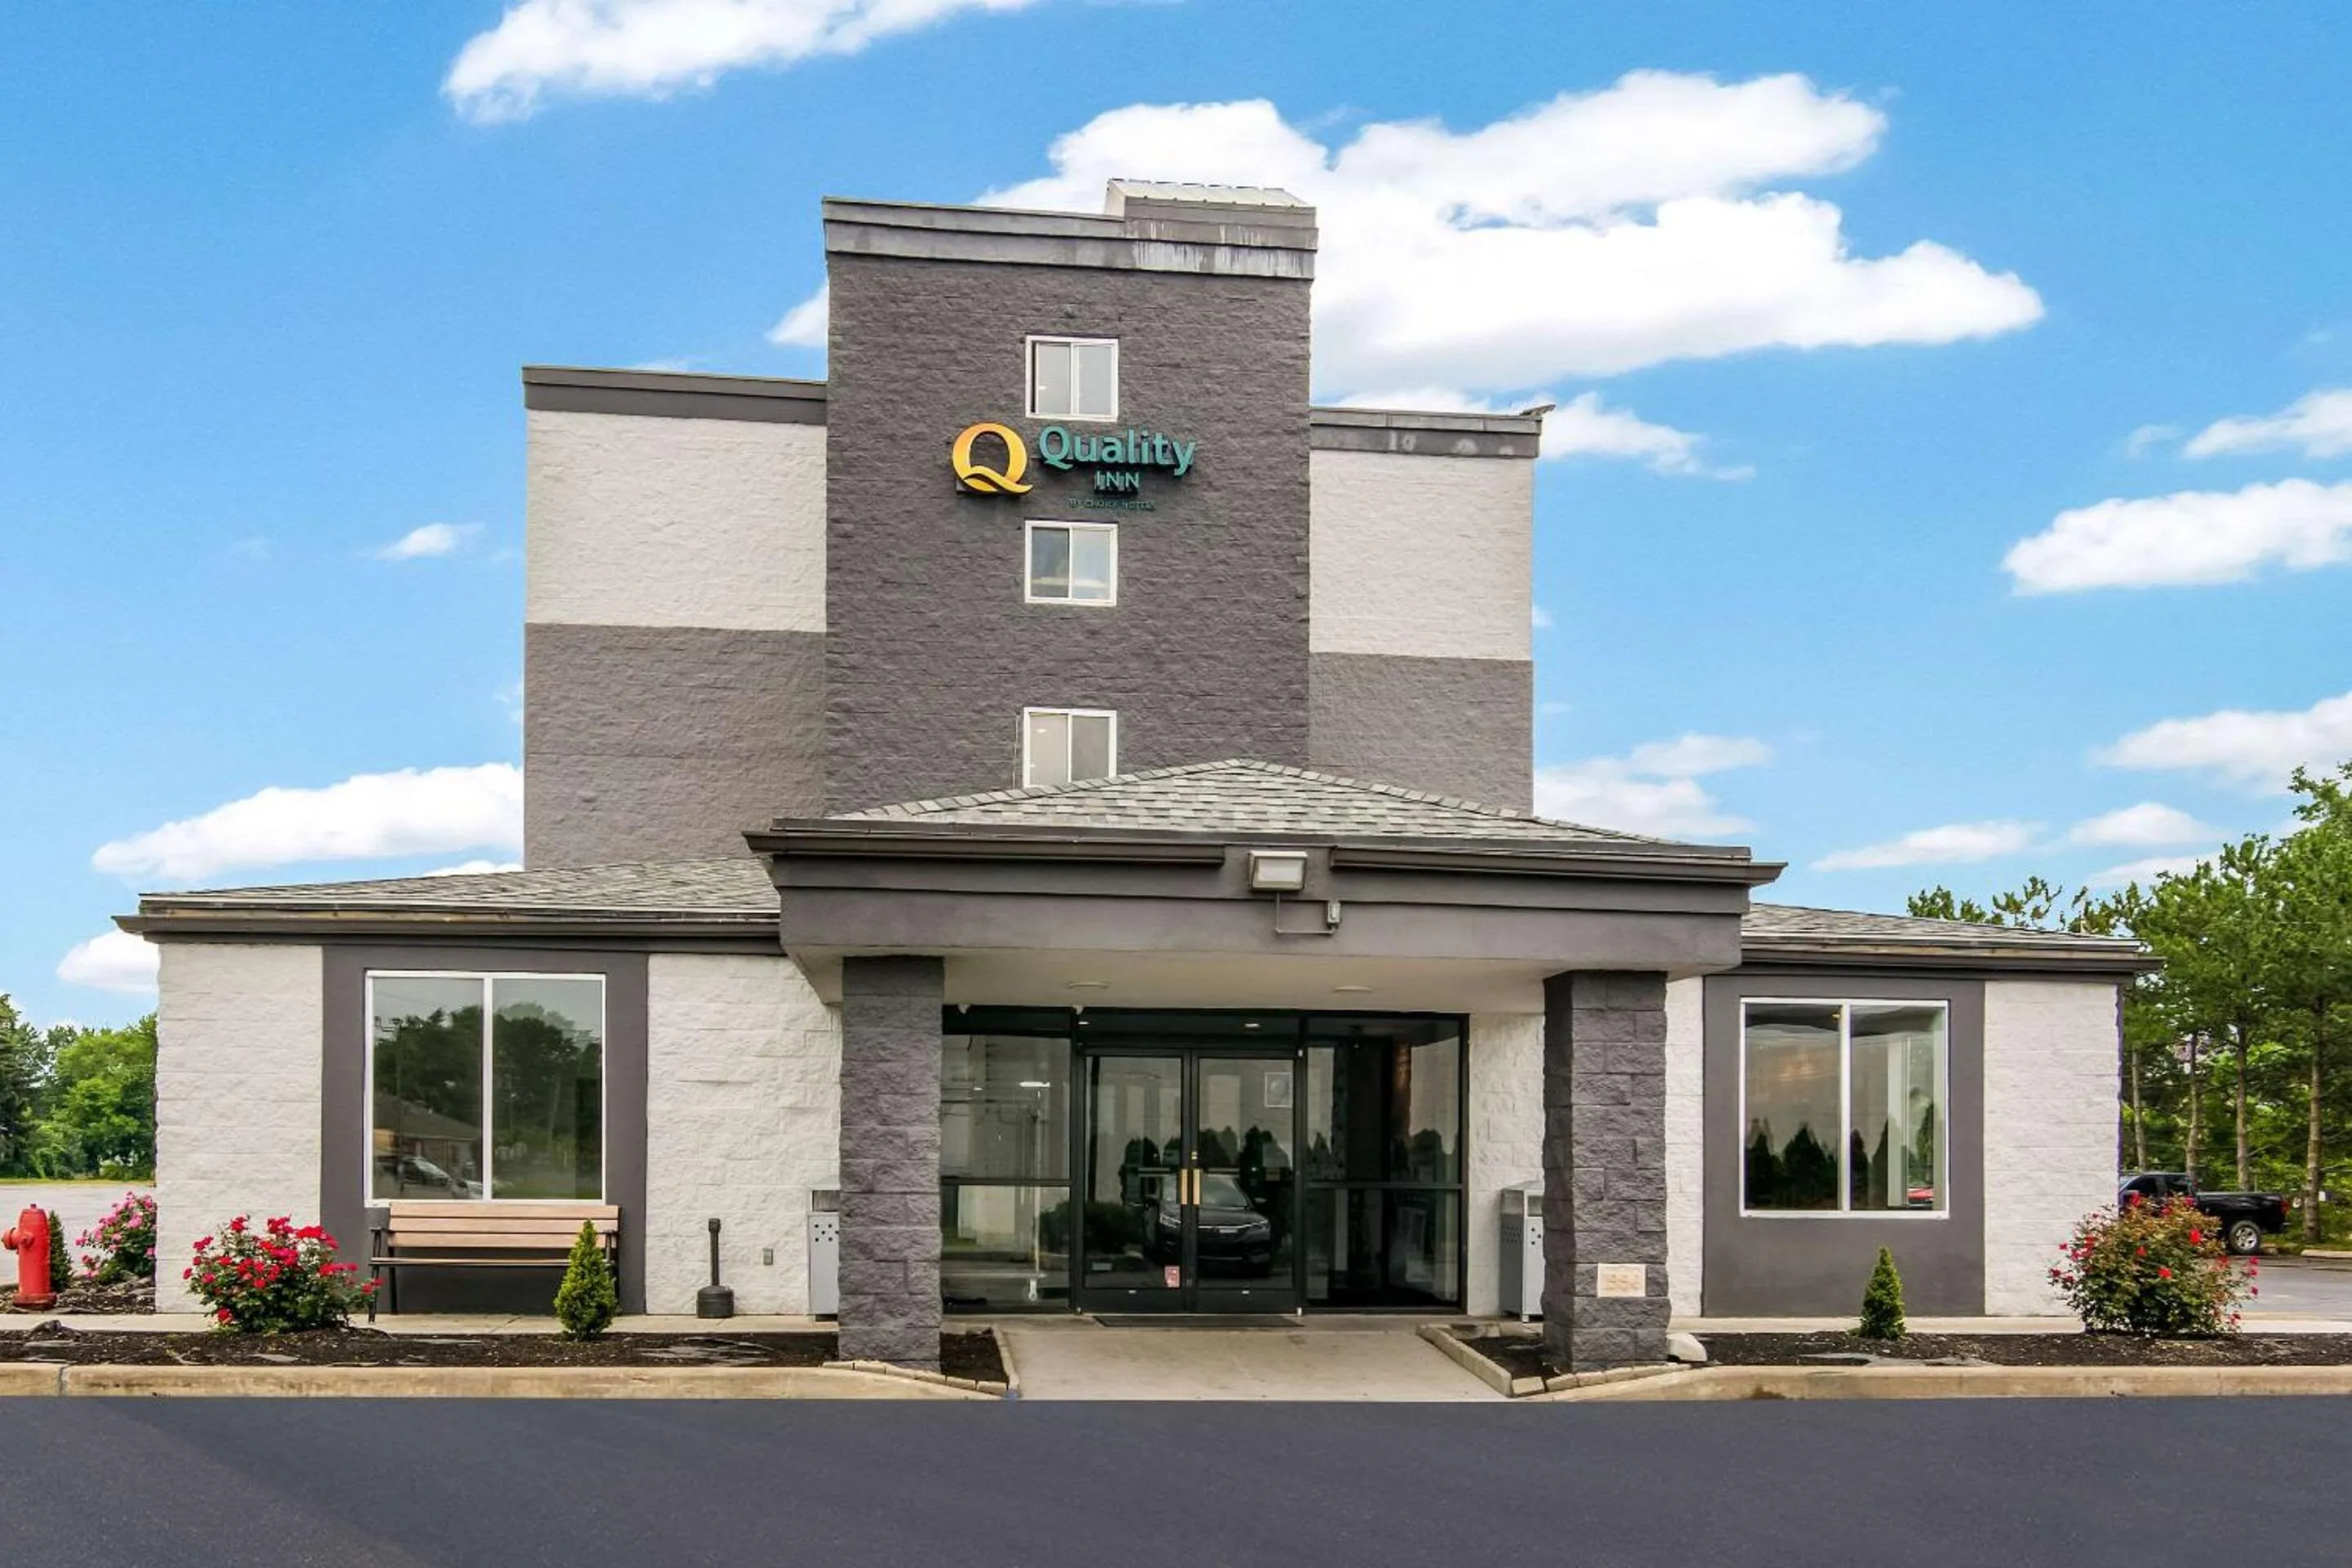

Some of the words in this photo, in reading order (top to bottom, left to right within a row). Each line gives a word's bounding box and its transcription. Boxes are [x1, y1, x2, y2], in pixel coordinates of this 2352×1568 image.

[952, 422, 1033, 493] Q
[1039, 425, 1196, 476] Quality
[1096, 471, 1139, 491] INN
